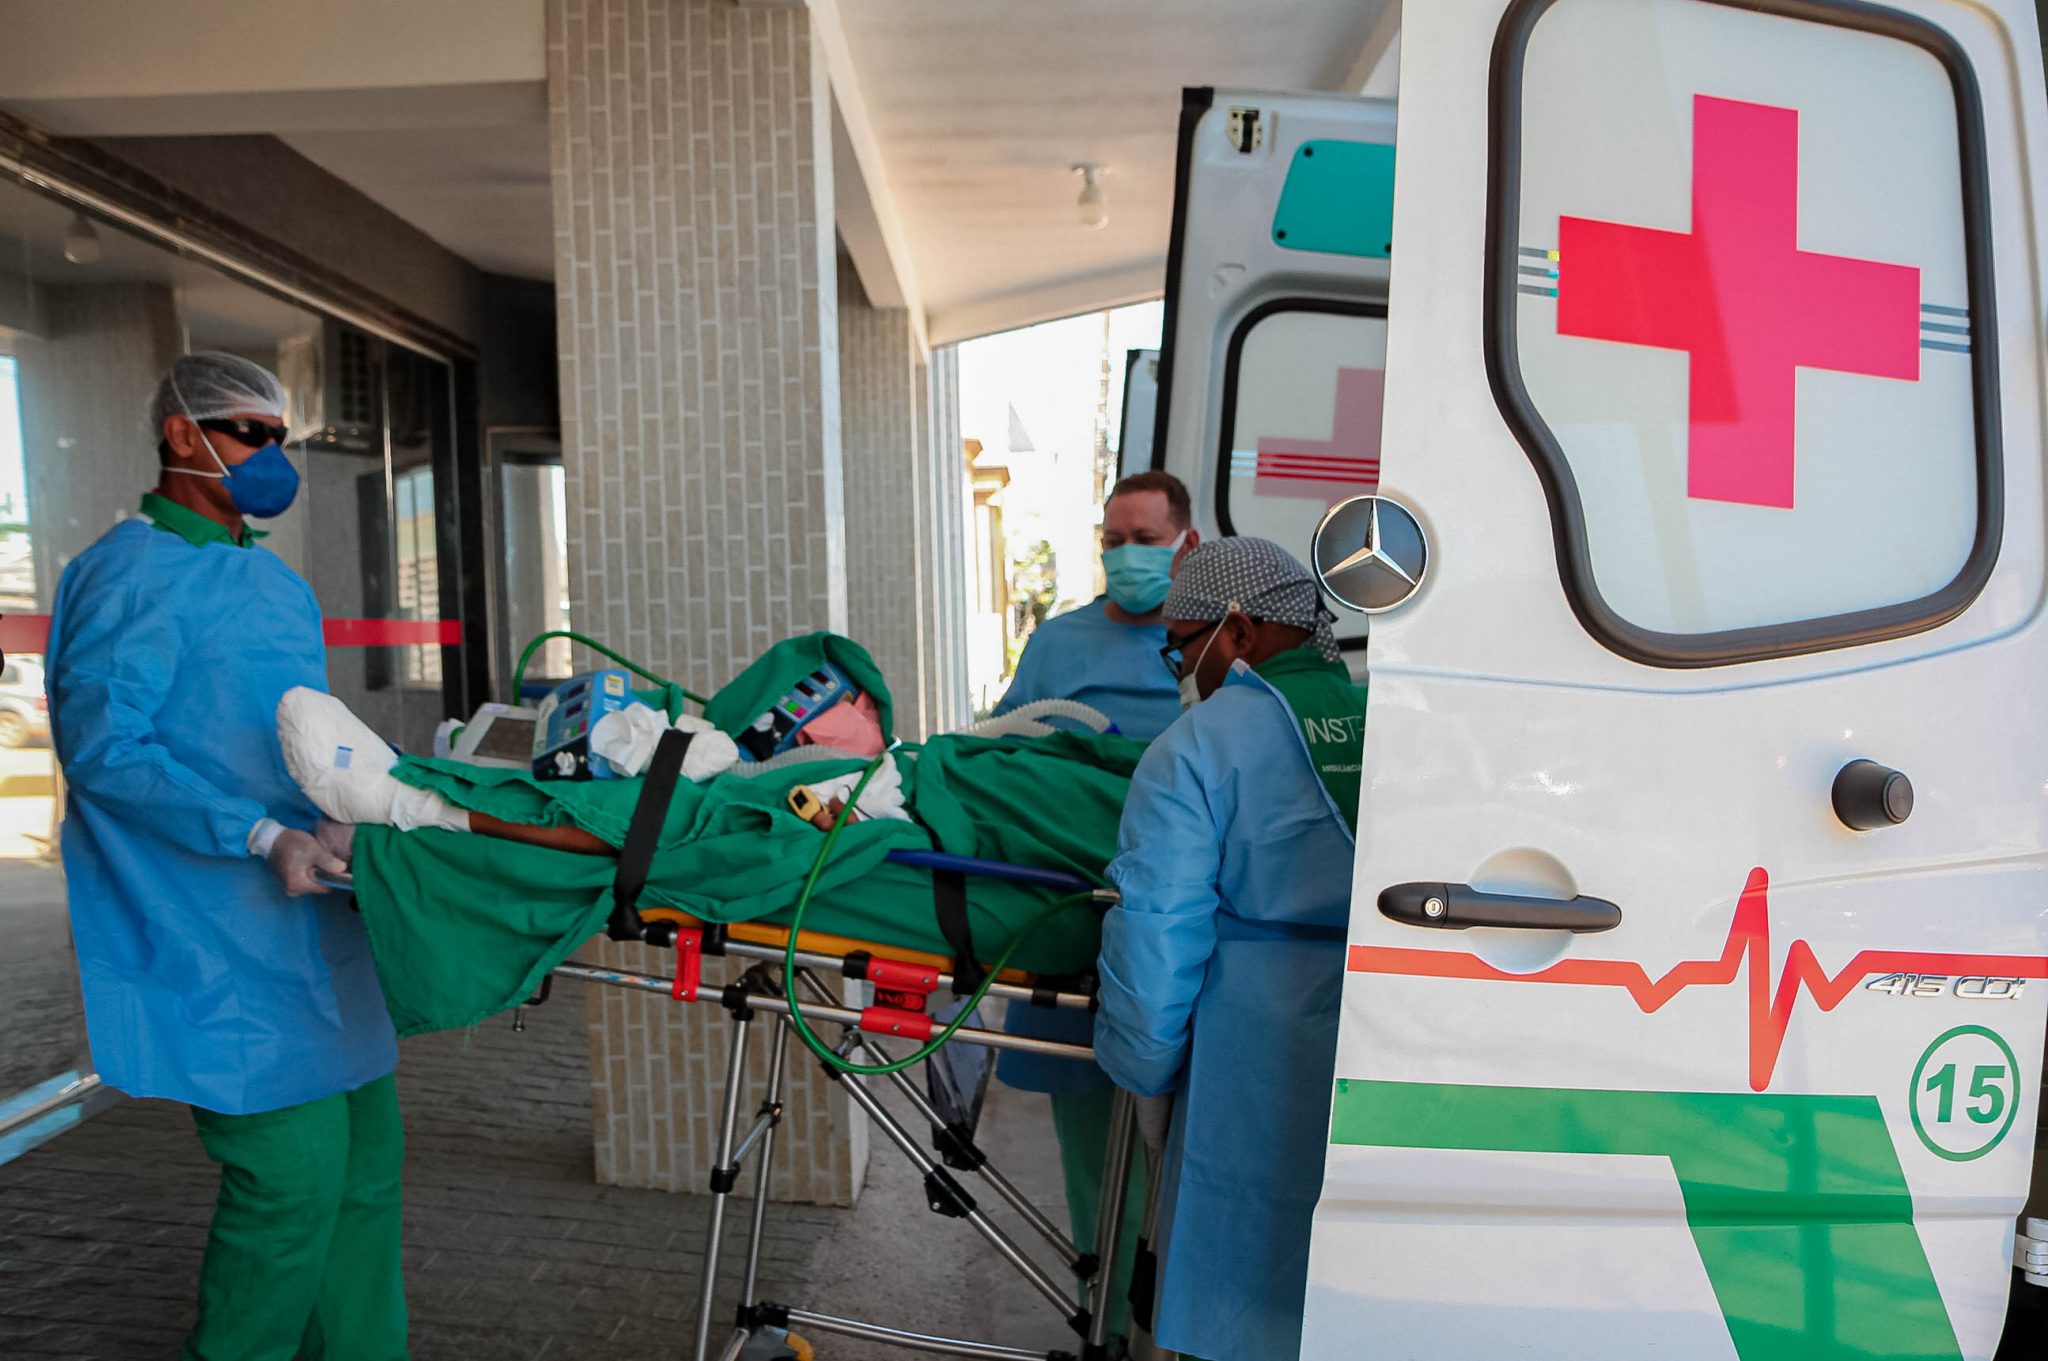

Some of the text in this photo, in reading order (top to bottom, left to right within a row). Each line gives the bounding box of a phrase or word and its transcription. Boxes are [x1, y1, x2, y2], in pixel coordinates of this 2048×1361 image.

[1304, 716, 1364, 743] INST
[1866, 973, 1948, 997] 415
[1926, 1063, 2005, 1124] 15
